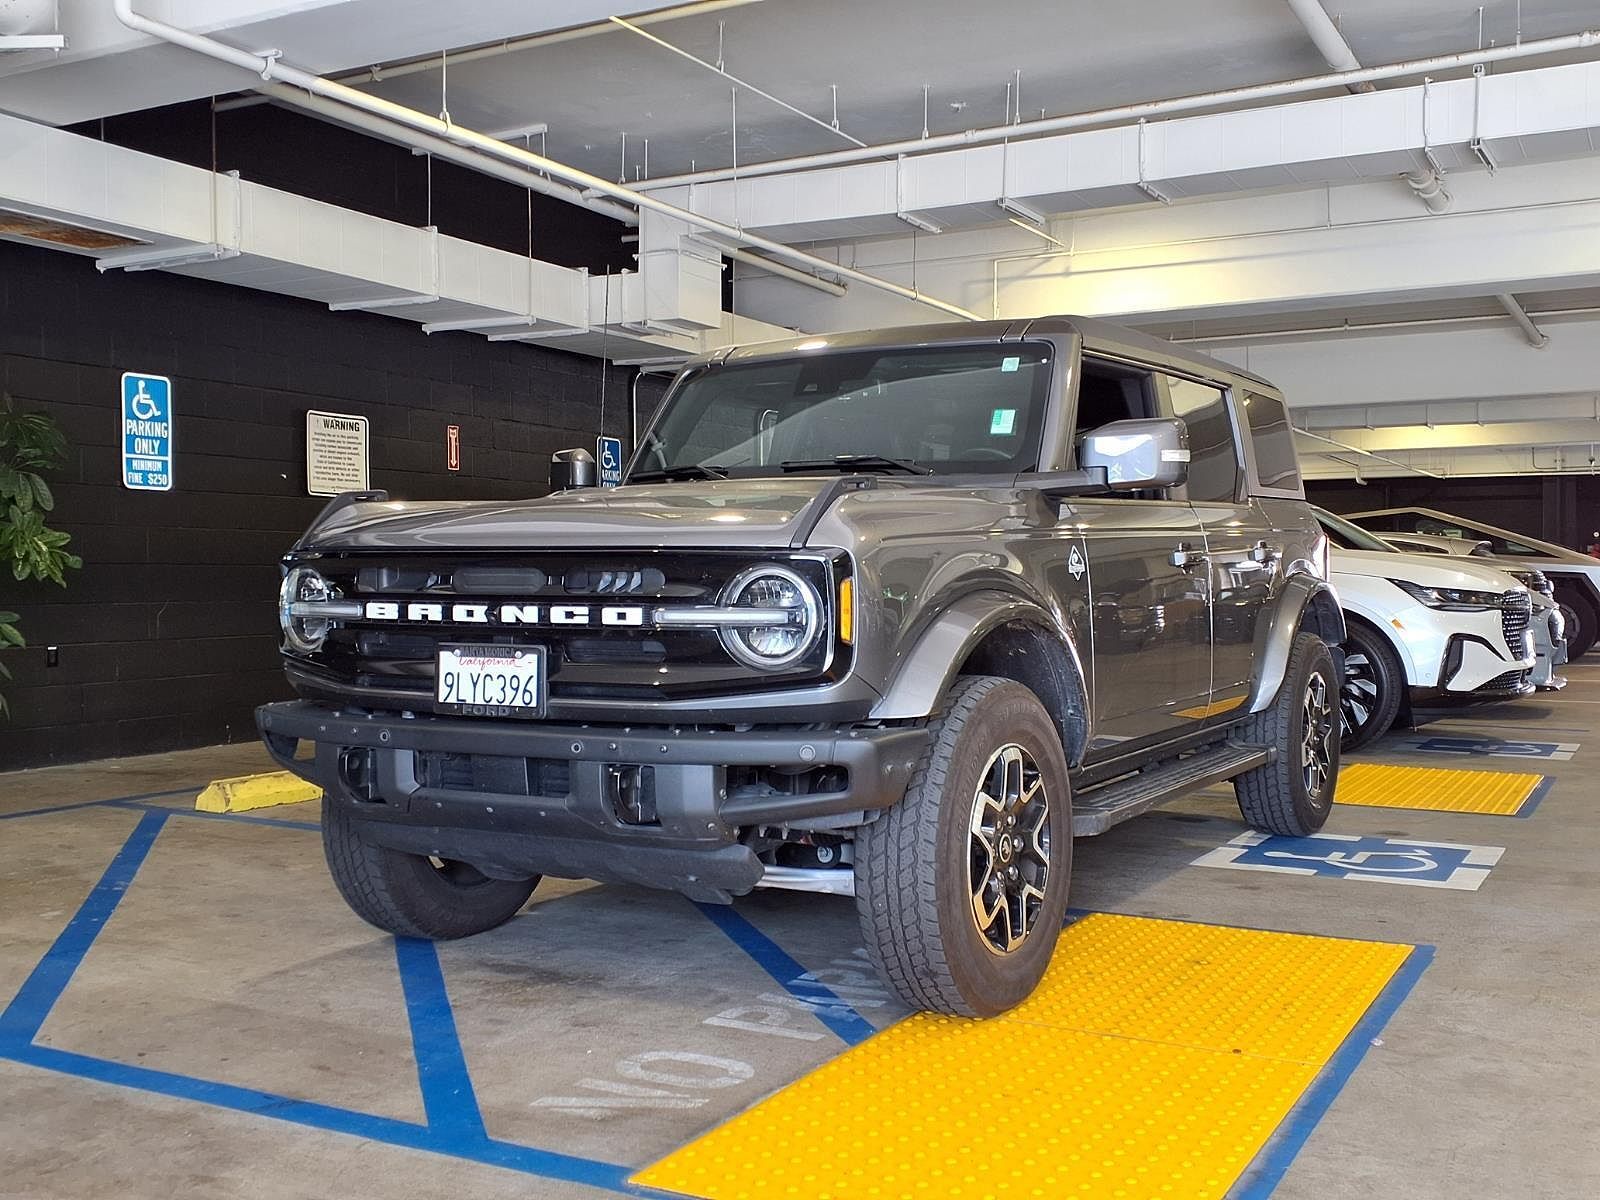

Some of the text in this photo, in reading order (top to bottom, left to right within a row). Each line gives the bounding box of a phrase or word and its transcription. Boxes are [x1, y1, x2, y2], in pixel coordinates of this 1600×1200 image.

[126, 419, 168, 438] PARKING
[323, 419, 360, 432] WARNING
[134, 438, 160, 455] ONLY
[132, 460, 162, 472] MINIMUM
[128, 472, 168, 485] FINE $250
[601, 469, 620, 481] ARKING
[366, 602, 643, 626] BRONCO
[443, 672, 535, 706] 9LYC396
[463, 705, 511, 717] FORD
[529, 1050, 756, 1120] NO
